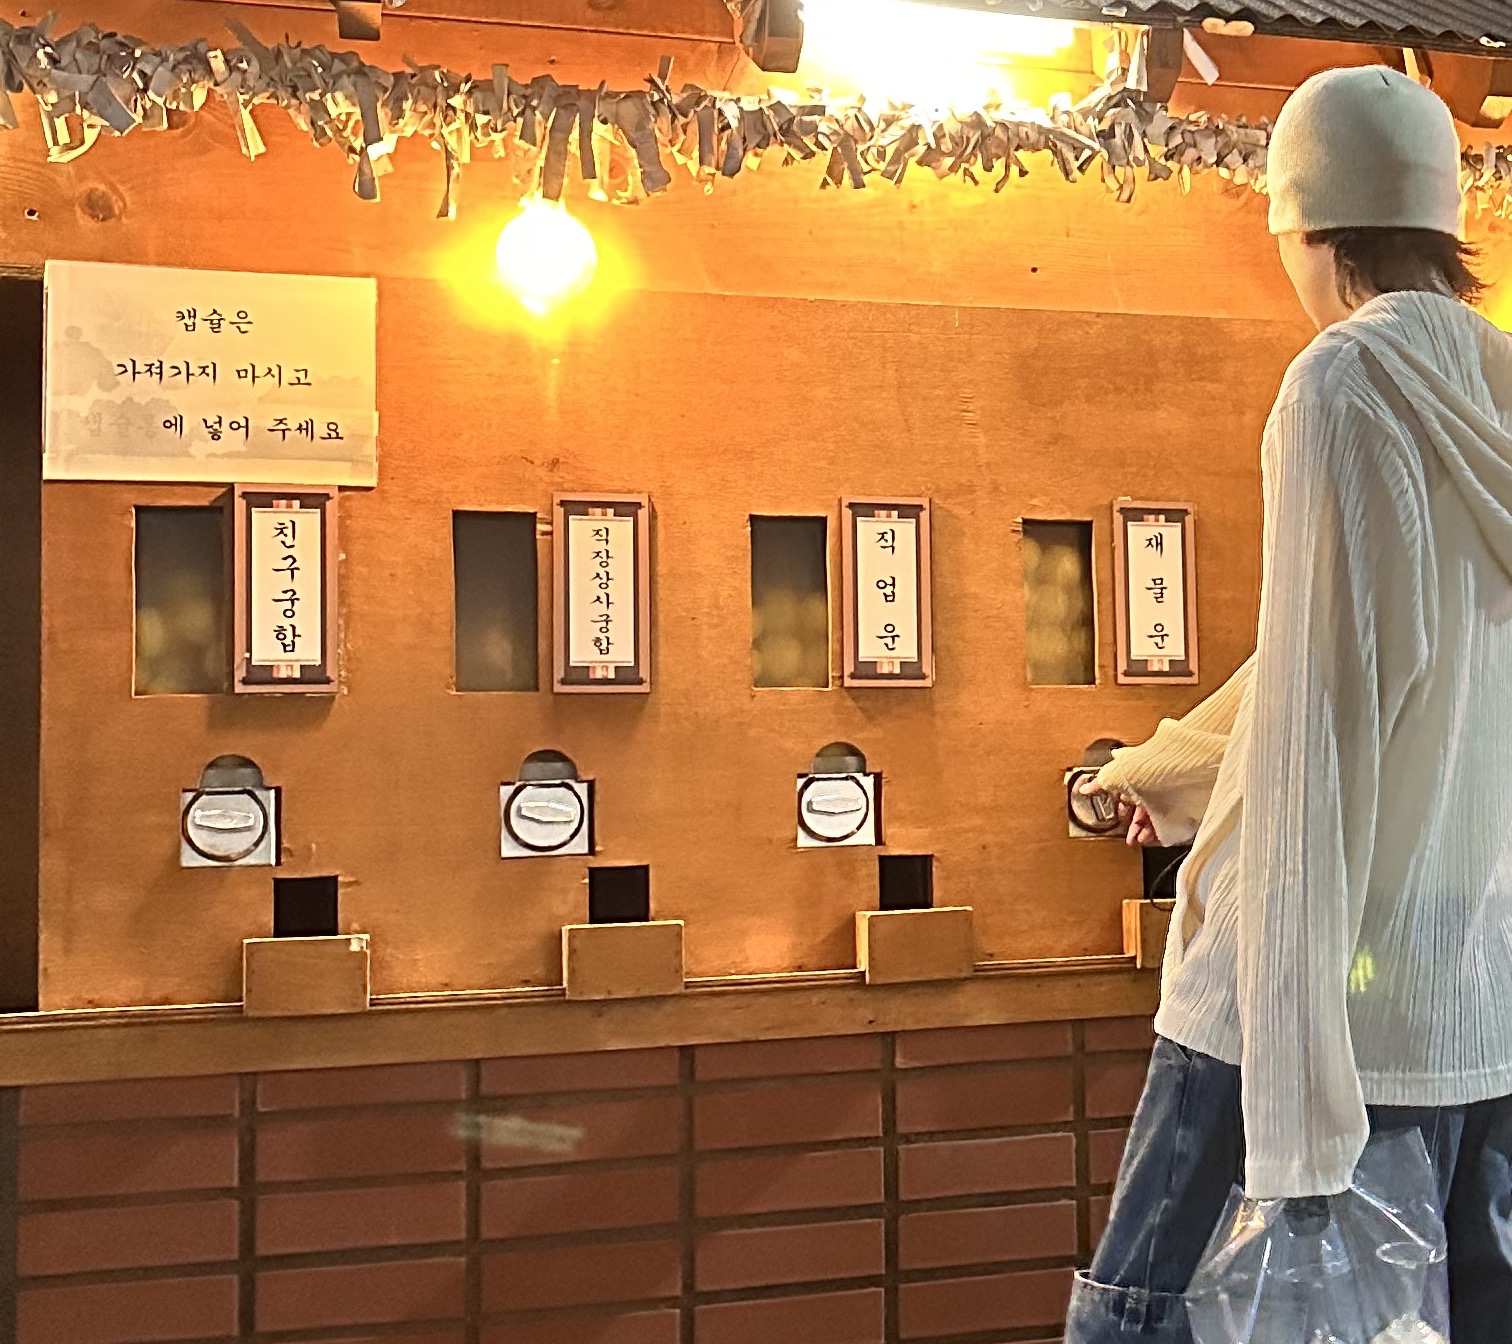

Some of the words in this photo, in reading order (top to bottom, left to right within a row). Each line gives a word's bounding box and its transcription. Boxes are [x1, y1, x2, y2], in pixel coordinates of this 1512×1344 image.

[116, 358, 218, 384] 가져가지
[235, 362, 312, 388] 마시고
[176, 308, 253, 334] 캡슐은
[202, 415, 250, 441] 넣어
[267, 417, 344, 442] 주세요
[271, 520, 302, 653] 친구궁합
[590, 526, 615, 656] 직장상사궁합
[875, 528, 901, 651] 직업운
[1144, 532, 1170, 649] 재물운
